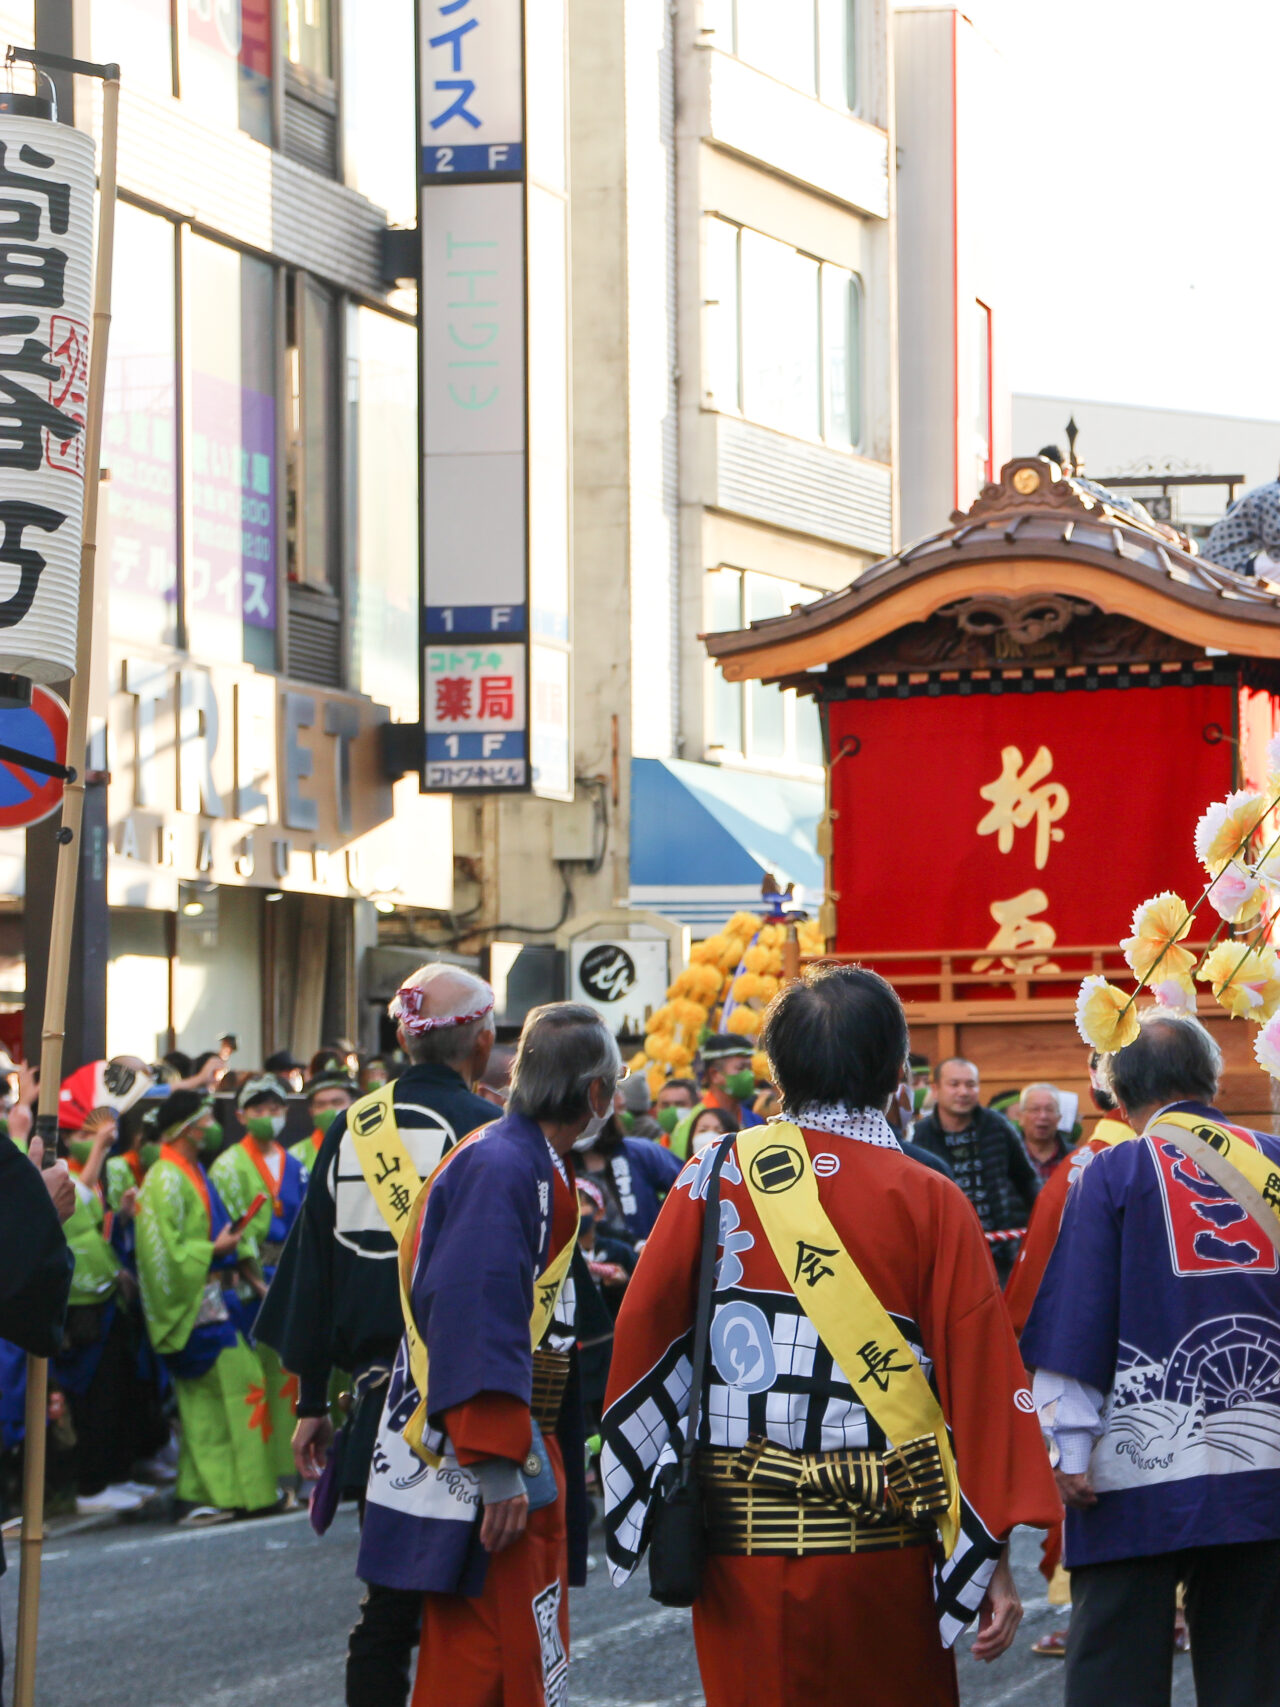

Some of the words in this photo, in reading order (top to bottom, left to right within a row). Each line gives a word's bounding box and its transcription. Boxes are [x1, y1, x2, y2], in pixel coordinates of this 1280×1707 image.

[429, 0, 482, 130] イス
[436, 676, 514, 722] 薬局
[374, 1152, 412, 1222] 山車
[793, 1240, 912, 1392] 会長
